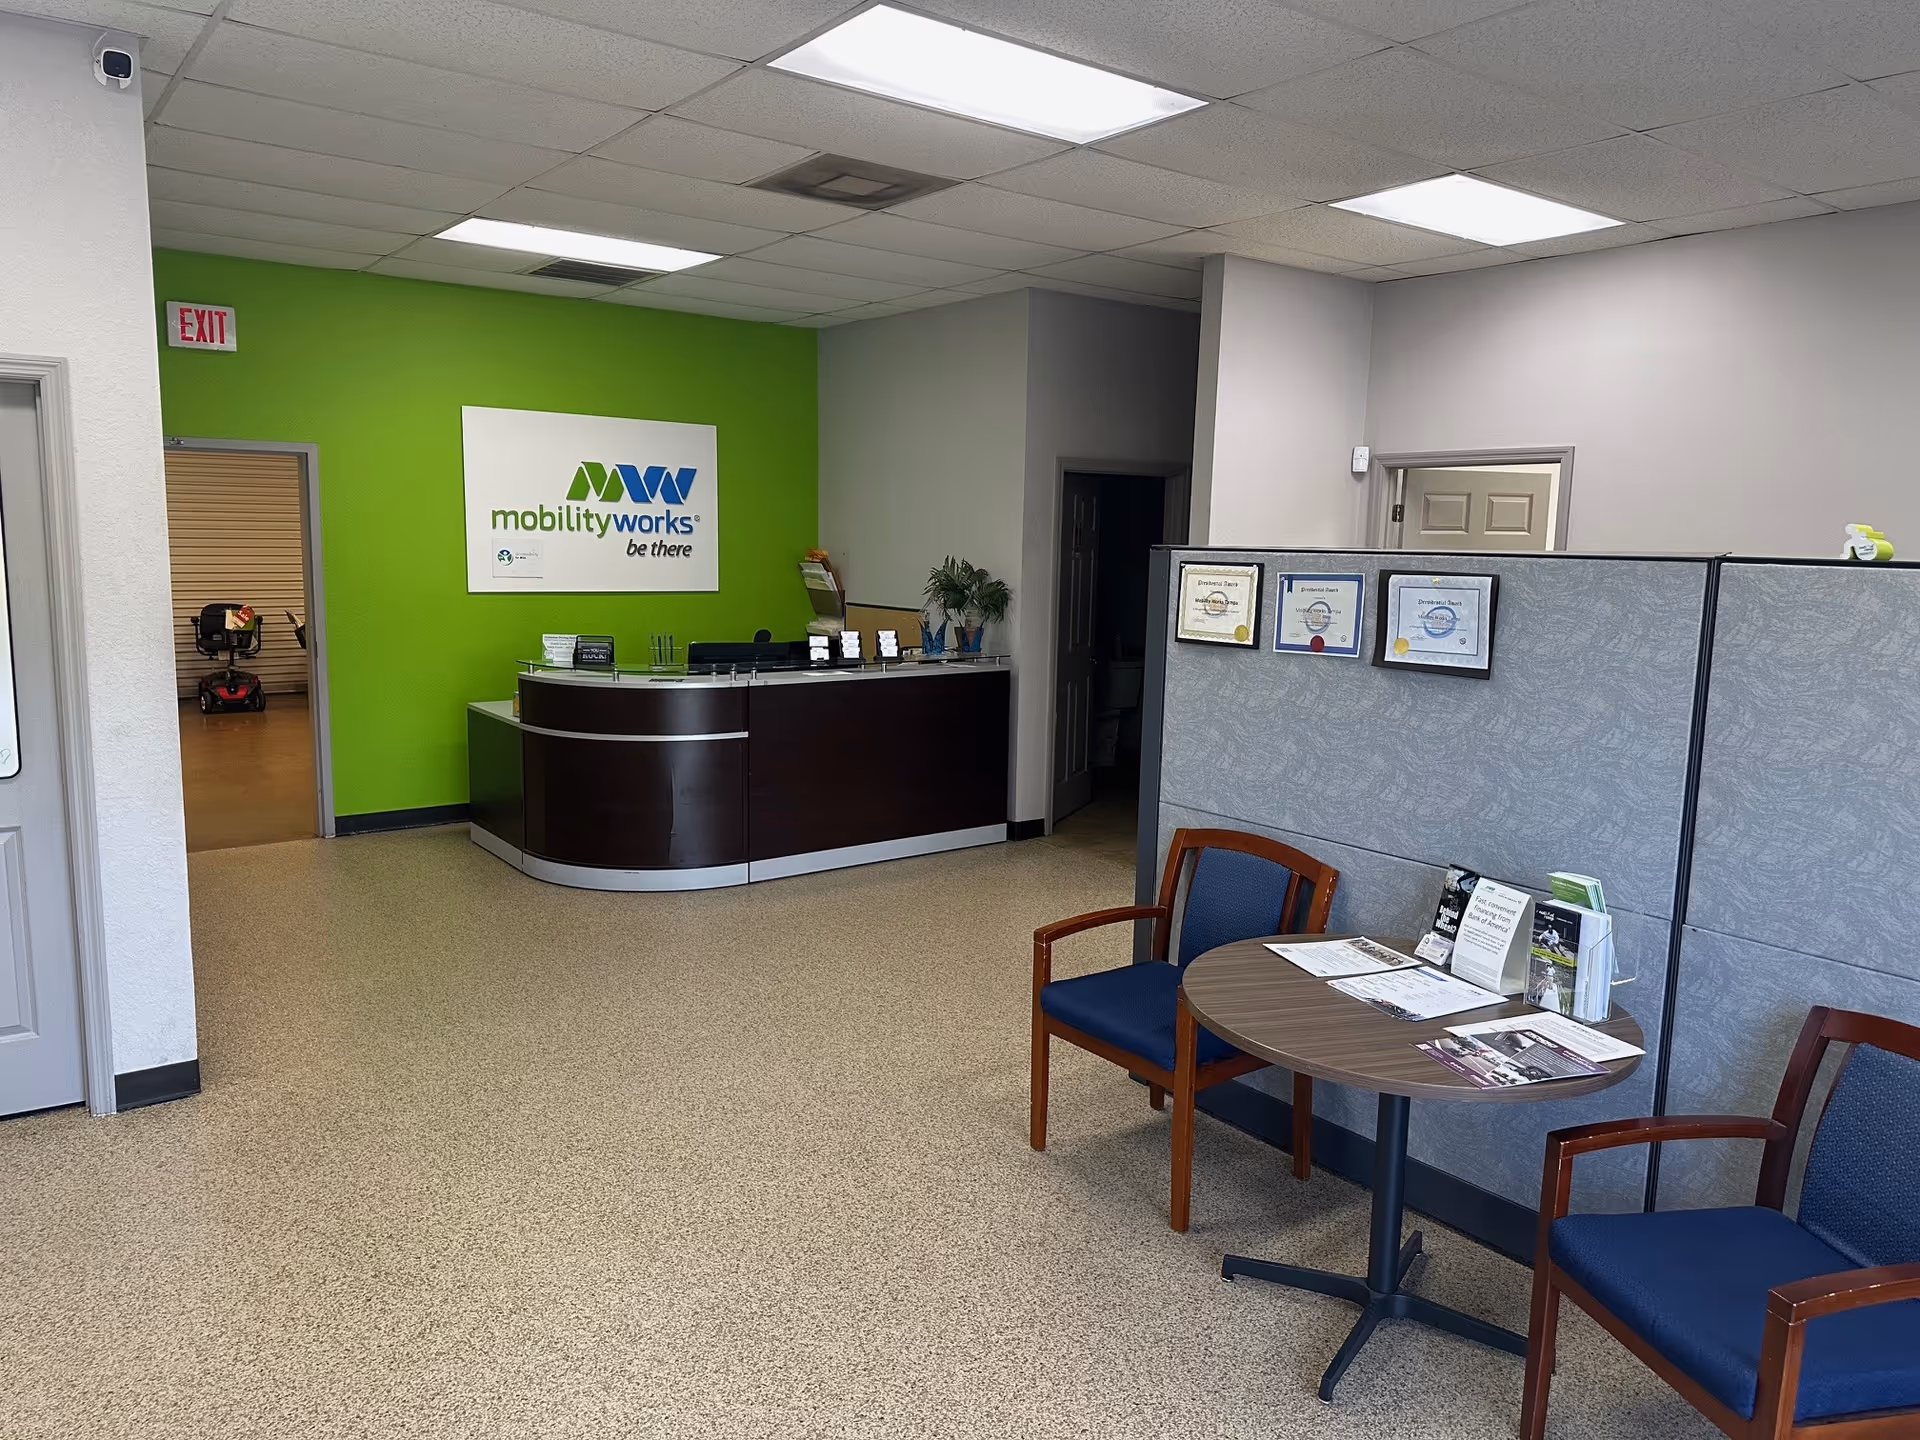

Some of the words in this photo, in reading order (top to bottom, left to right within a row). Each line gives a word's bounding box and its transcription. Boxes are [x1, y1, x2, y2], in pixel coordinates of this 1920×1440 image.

[179, 307, 227, 344] EXIT
[626, 538, 648, 556] be
[650, 540, 693, 557] there
